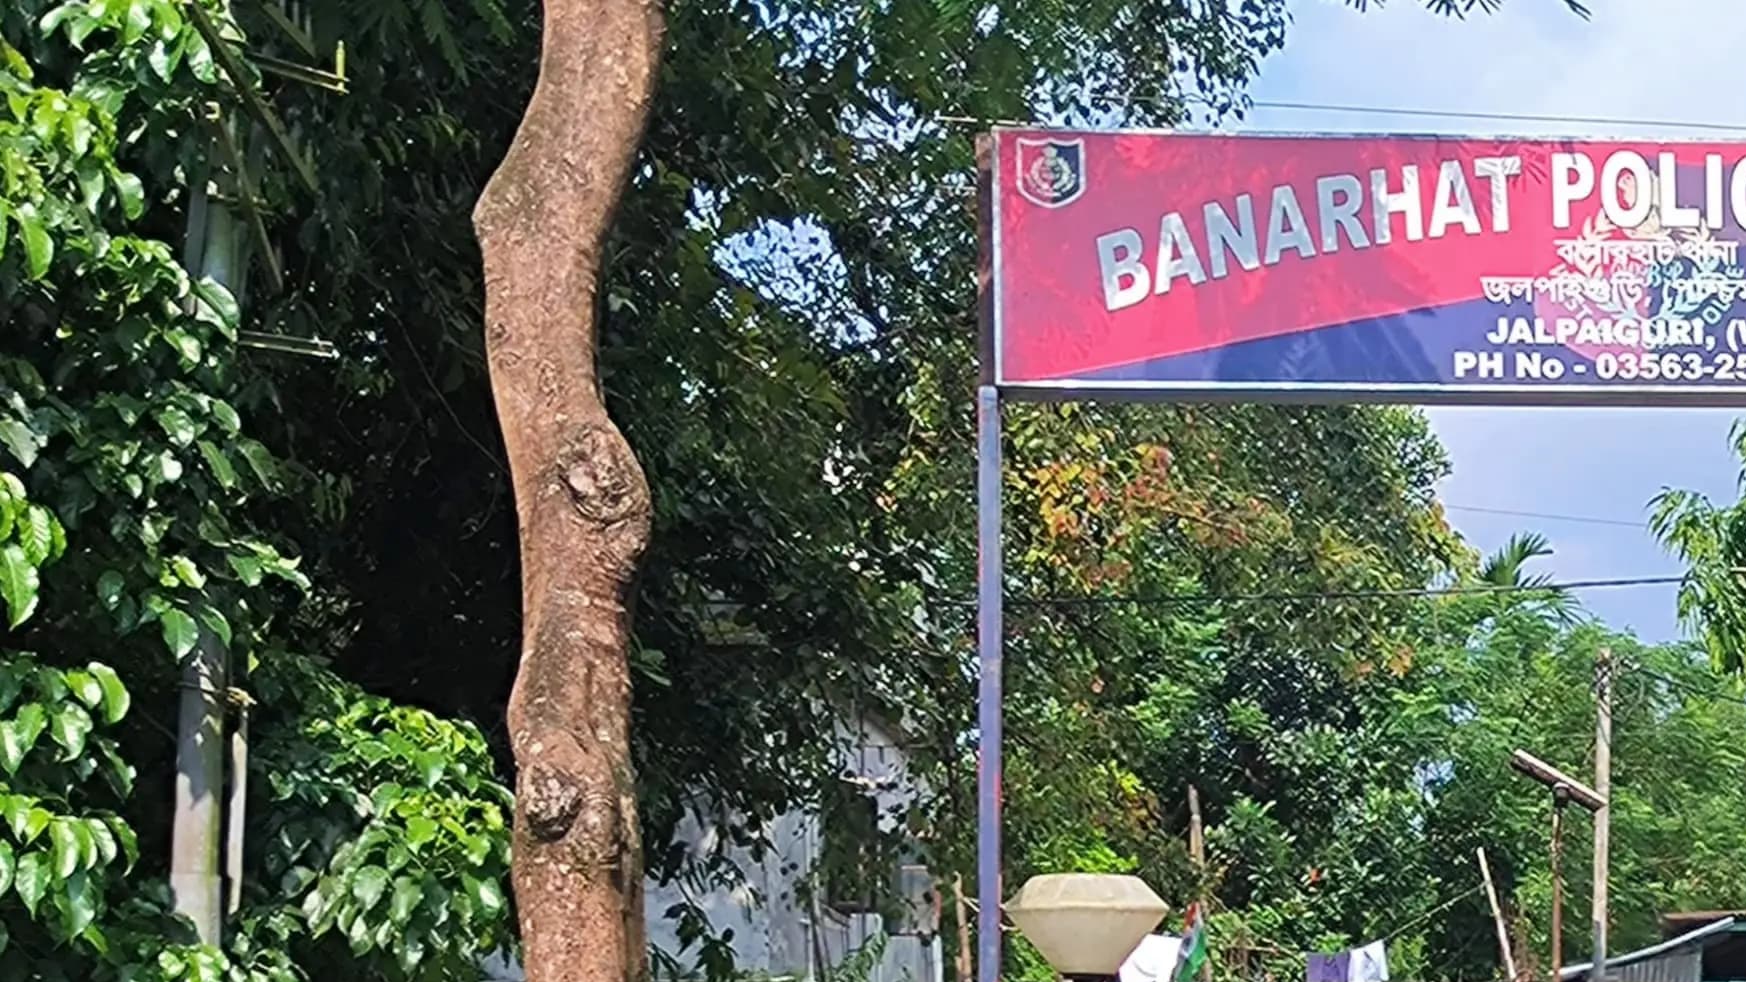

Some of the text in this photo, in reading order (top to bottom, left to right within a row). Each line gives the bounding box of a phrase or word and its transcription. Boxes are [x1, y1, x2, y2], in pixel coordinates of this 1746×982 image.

[1095, 155, 1521, 312] BANARHAT
[1486, 317, 1716, 351] JALPAIGURI,
[1453, 351, 1504, 379] PH
[1515, 352, 1564, 379] No
